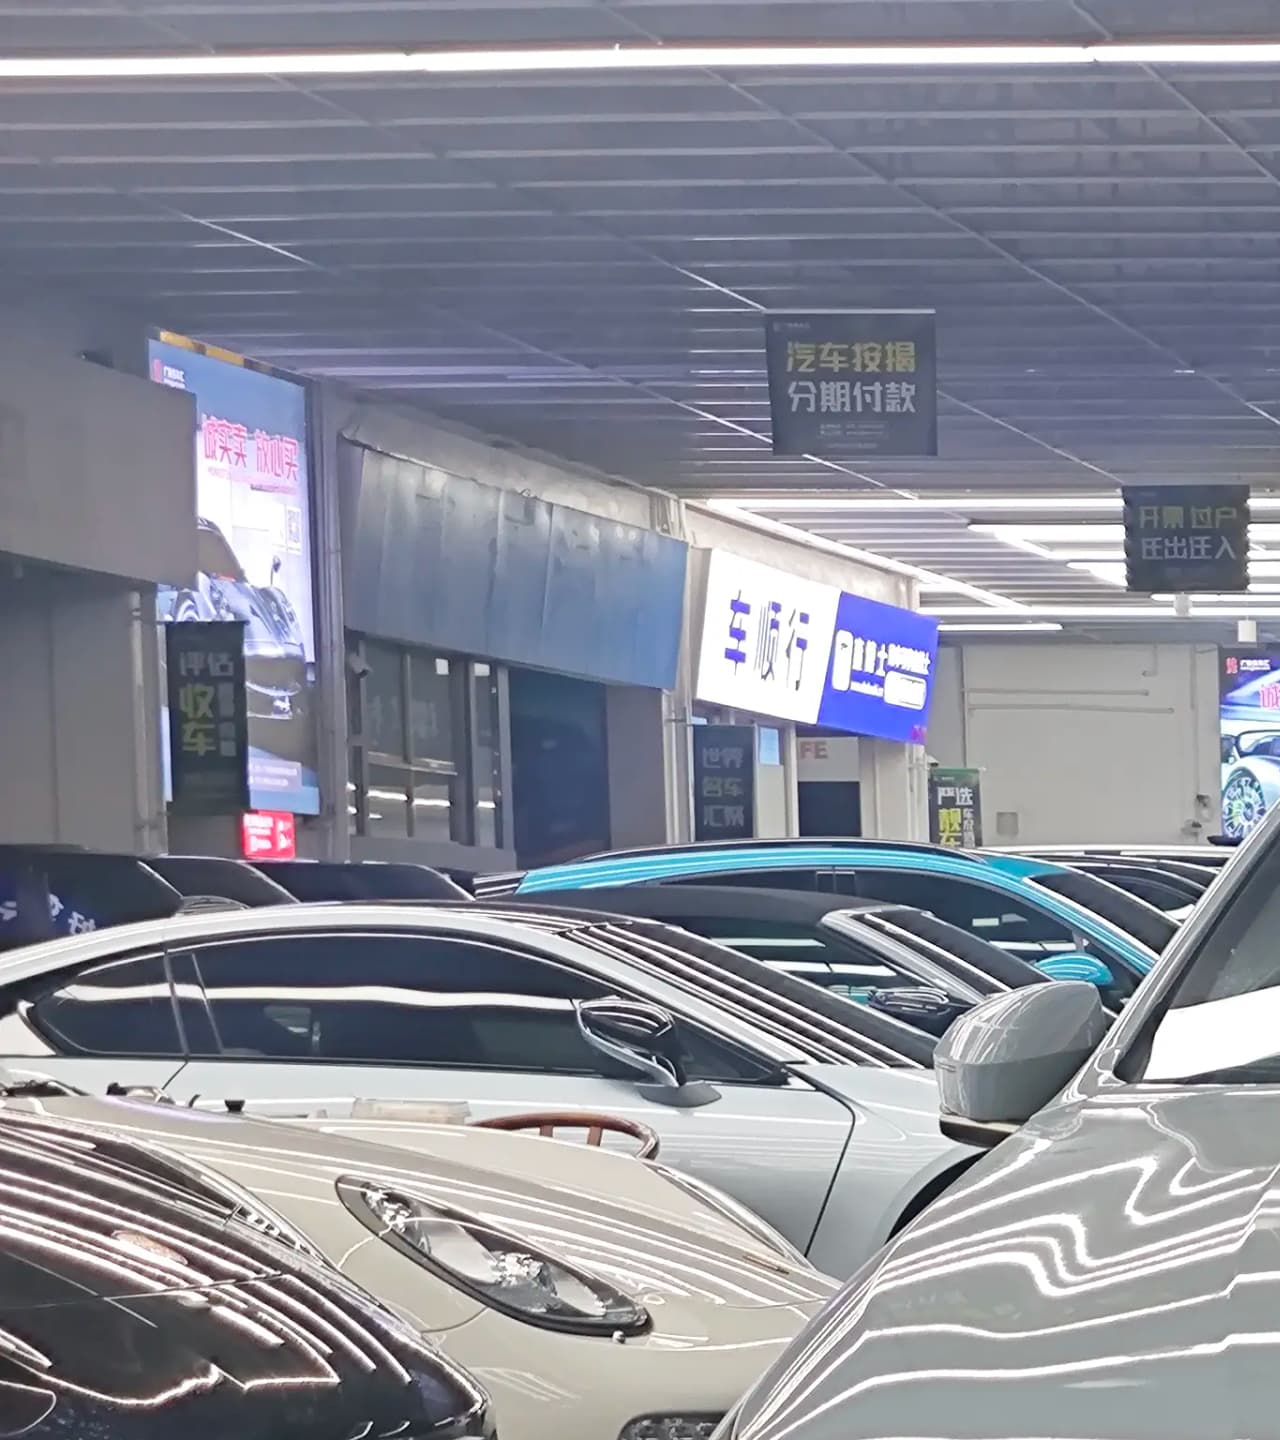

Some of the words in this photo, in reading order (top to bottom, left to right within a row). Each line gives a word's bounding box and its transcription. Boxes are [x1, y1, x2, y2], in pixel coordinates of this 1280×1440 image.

[787, 341, 916, 372] 汽车按揭
[788, 381, 916, 413] 分期付款
[937, 787, 973, 805] 严选
